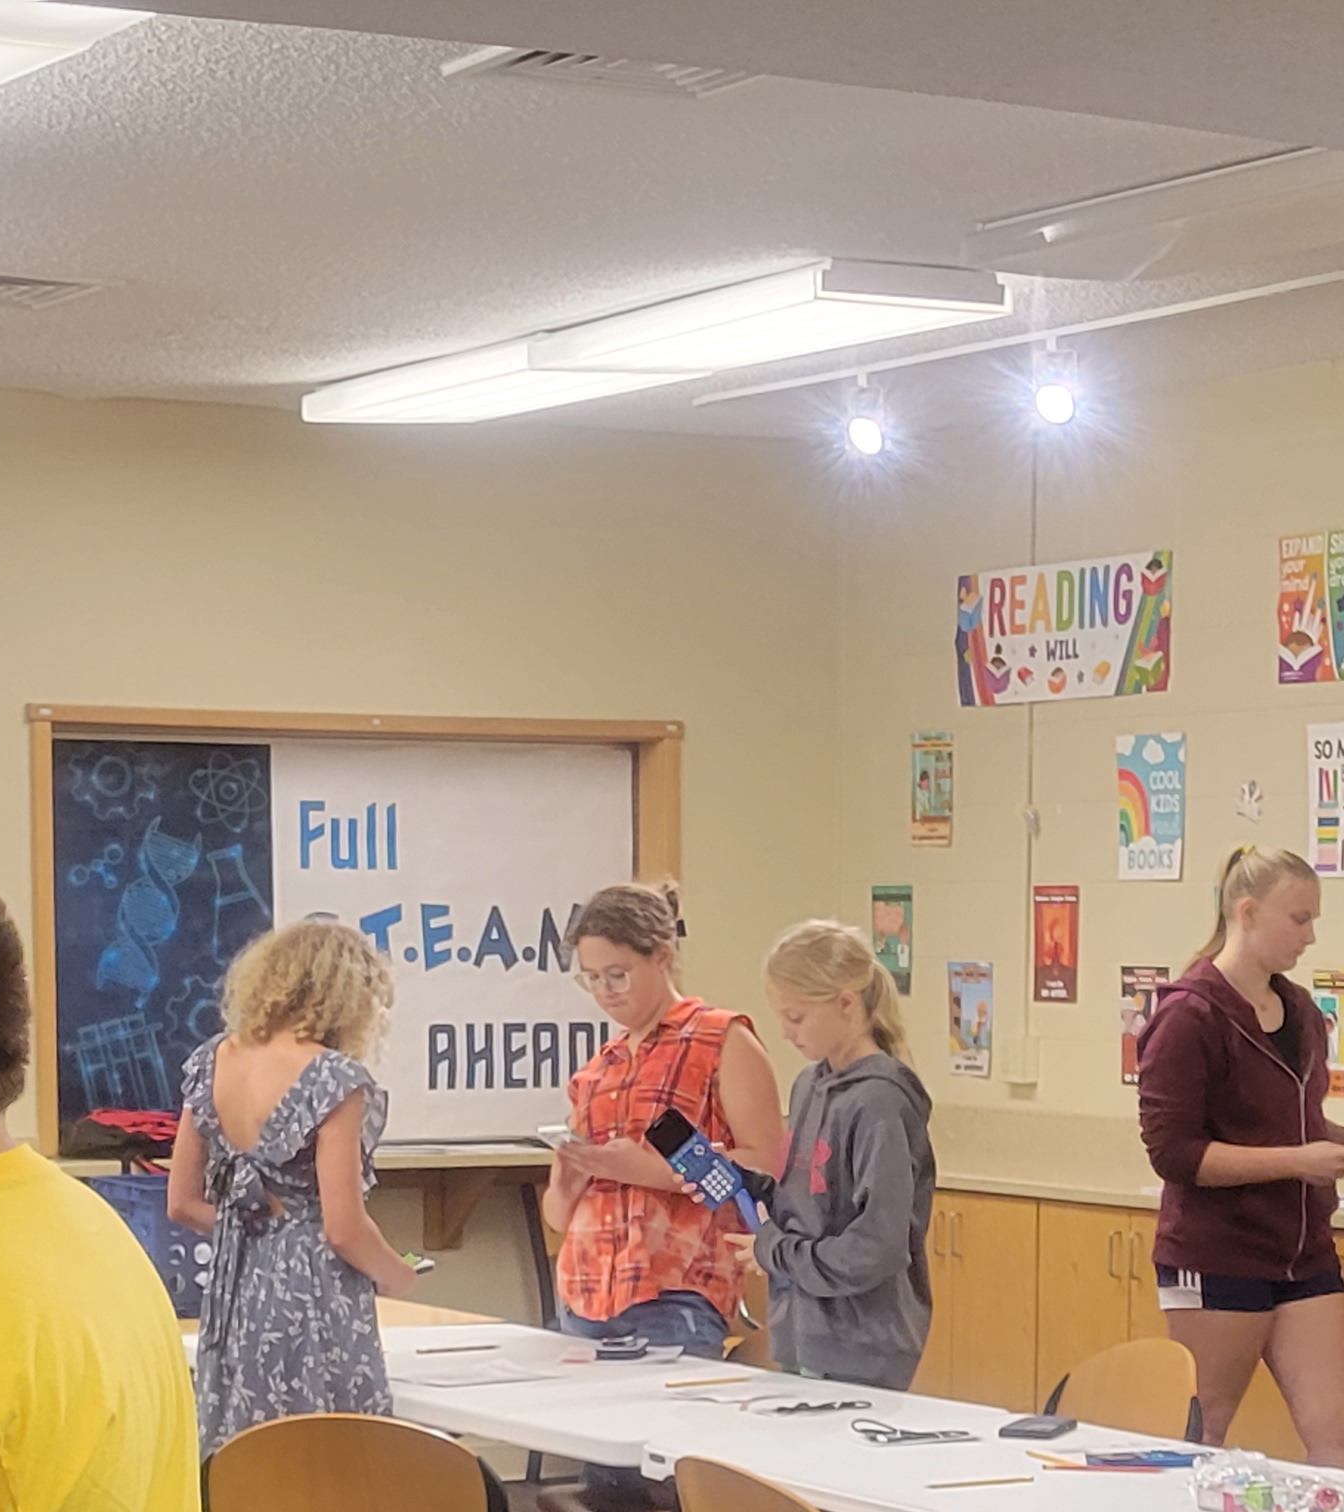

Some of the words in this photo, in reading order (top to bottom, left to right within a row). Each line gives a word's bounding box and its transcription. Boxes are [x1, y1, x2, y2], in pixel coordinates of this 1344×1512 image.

[1281, 535, 1323, 559] EXPAND
[1280, 560, 1305, 579] your
[989, 563, 1133, 638] READING
[1046, 639, 1079, 661] WILL
[1314, 740, 1333, 759] SO
[1149, 769, 1183, 791] COOL
[1150, 793, 1180, 813] KIDS
[299, 800, 398, 870] Full
[1127, 848, 1174, 870] BOOKS
